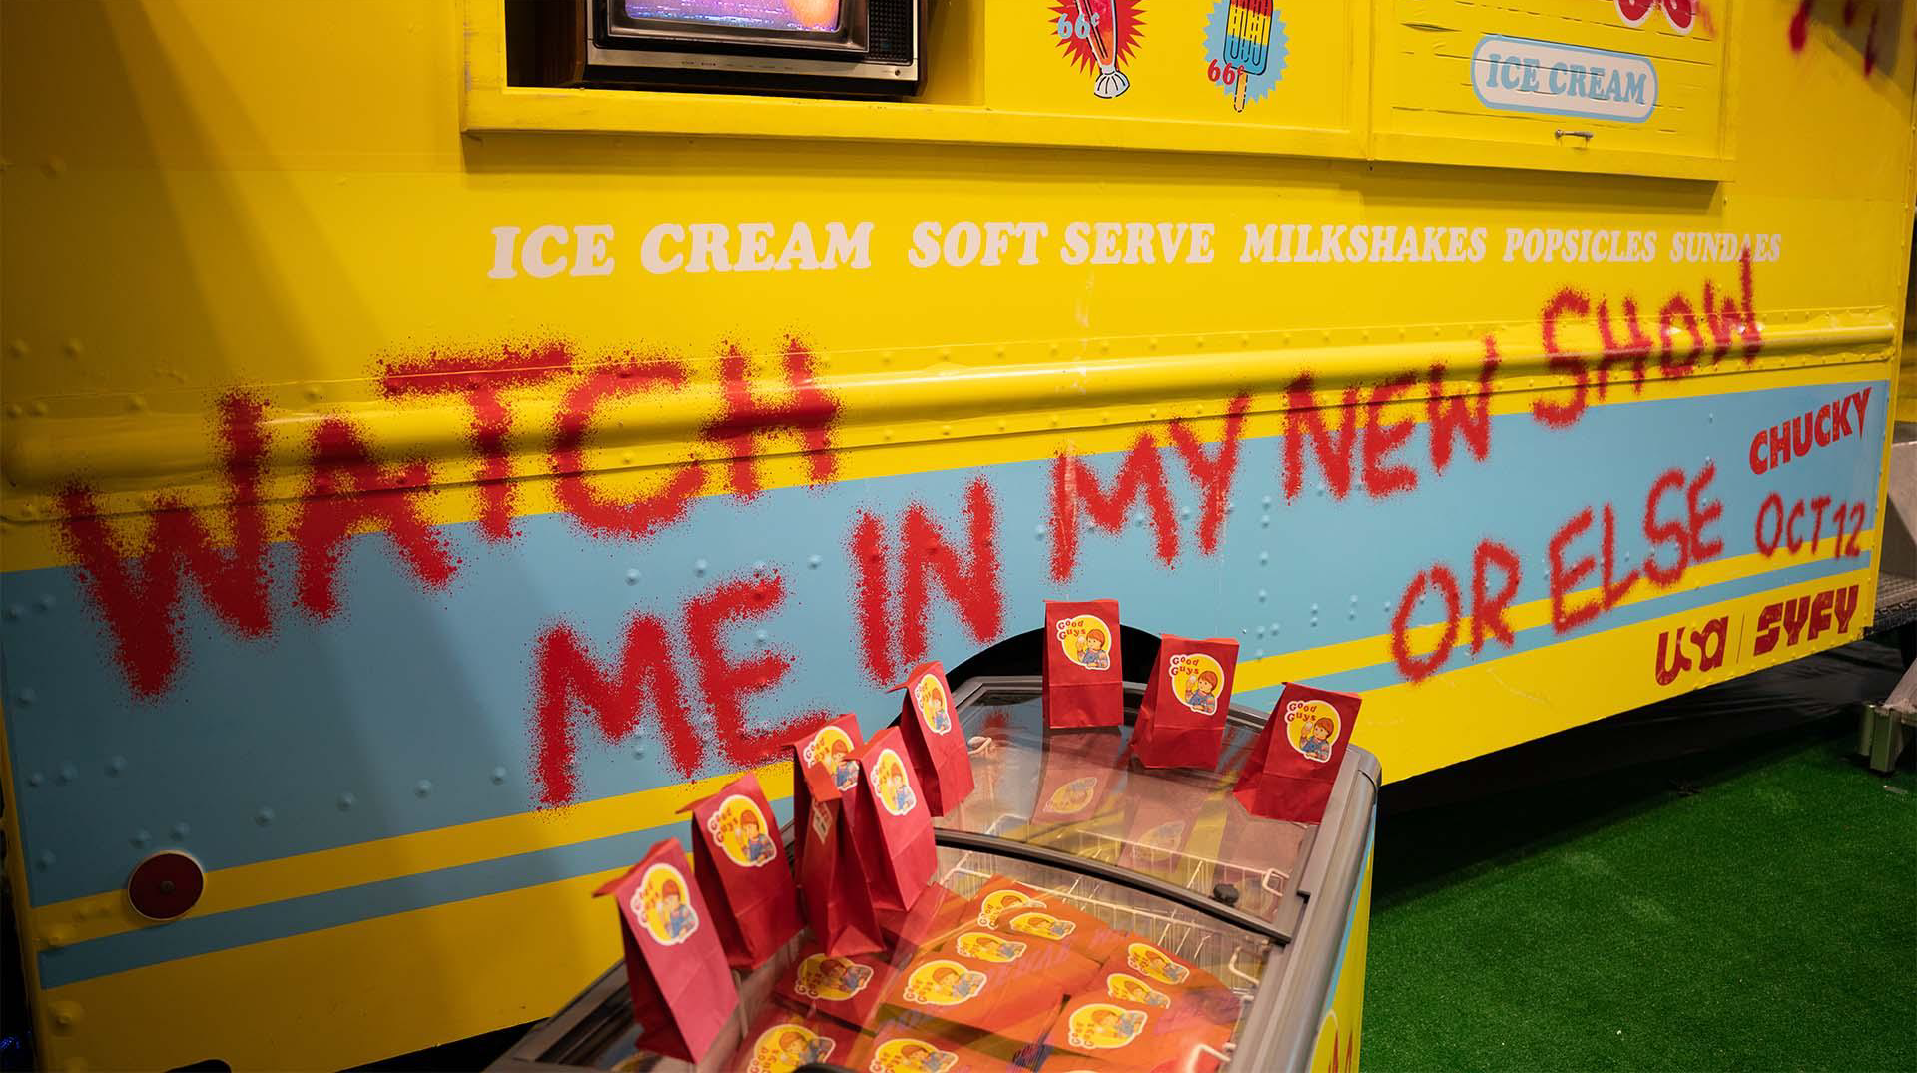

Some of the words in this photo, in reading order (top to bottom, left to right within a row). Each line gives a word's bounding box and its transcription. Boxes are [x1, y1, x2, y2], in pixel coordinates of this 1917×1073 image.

[1486, 54, 1538, 92] ICE
[1549, 62, 1646, 105] CREAM
[488, 225, 613, 278] ICE
[641, 222, 875, 272] CREAM
[909, 222, 1048, 268] SOFT
[1061, 222, 1214, 264] SERVE
[1240, 224, 1486, 262] MILKSHAKES
[1503, 228, 1657, 262] POPSICLES
[1669, 232, 1781, 263] SUNDAES
[1749, 387, 1873, 475] CHUCKY
[60, 340, 838, 700] WATCH
[535, 572, 836, 806] ME
[850, 477, 1005, 686] IN
[1049, 391, 1251, 582] MY
[1281, 335, 1500, 500] NEW
[1533, 246, 1764, 428] SHOW
[1755, 493, 1831, 558] OCT
[1832, 502, 1868, 560] 12
[1392, 540, 1520, 683] OR
[1547, 462, 1724, 634] ELSE
[1057, 619, 1085, 631] Good
[1058, 627, 1087, 641] Guys
[1754, 585, 1859, 656] SYFY
[1170, 665, 1200, 677] Guys
[1171, 655, 1200, 666] Good
[1286, 711, 1317, 723] Guys
[1288, 701, 1318, 713] Good
